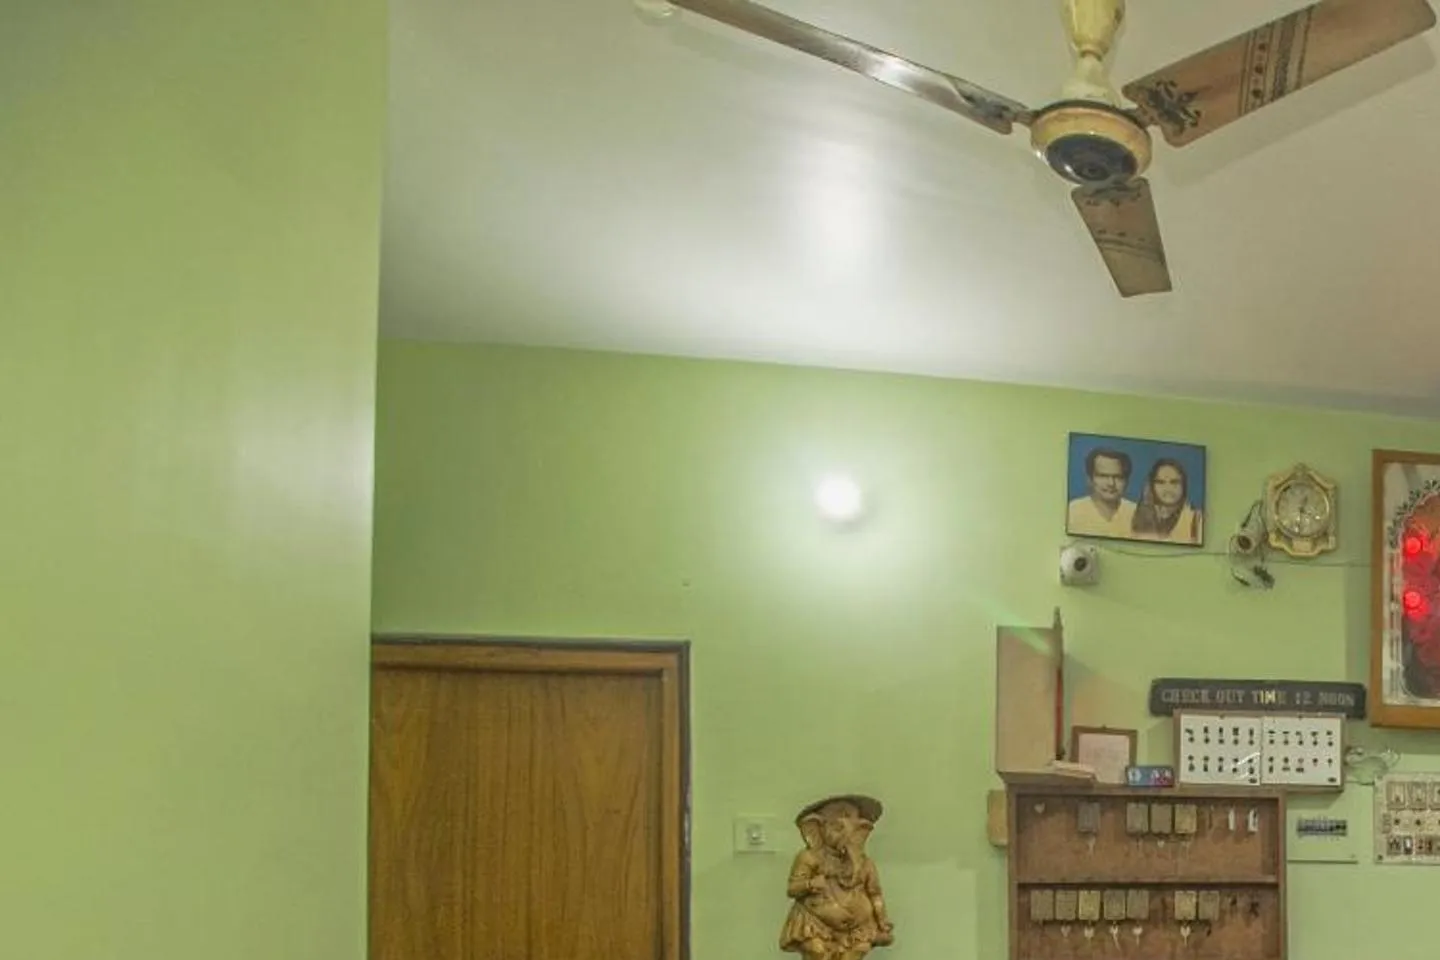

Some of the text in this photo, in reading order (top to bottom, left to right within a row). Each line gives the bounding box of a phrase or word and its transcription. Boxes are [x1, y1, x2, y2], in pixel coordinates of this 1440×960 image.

[1161, 687, 1356, 707] CHECK OUT TIME 12 NOON
